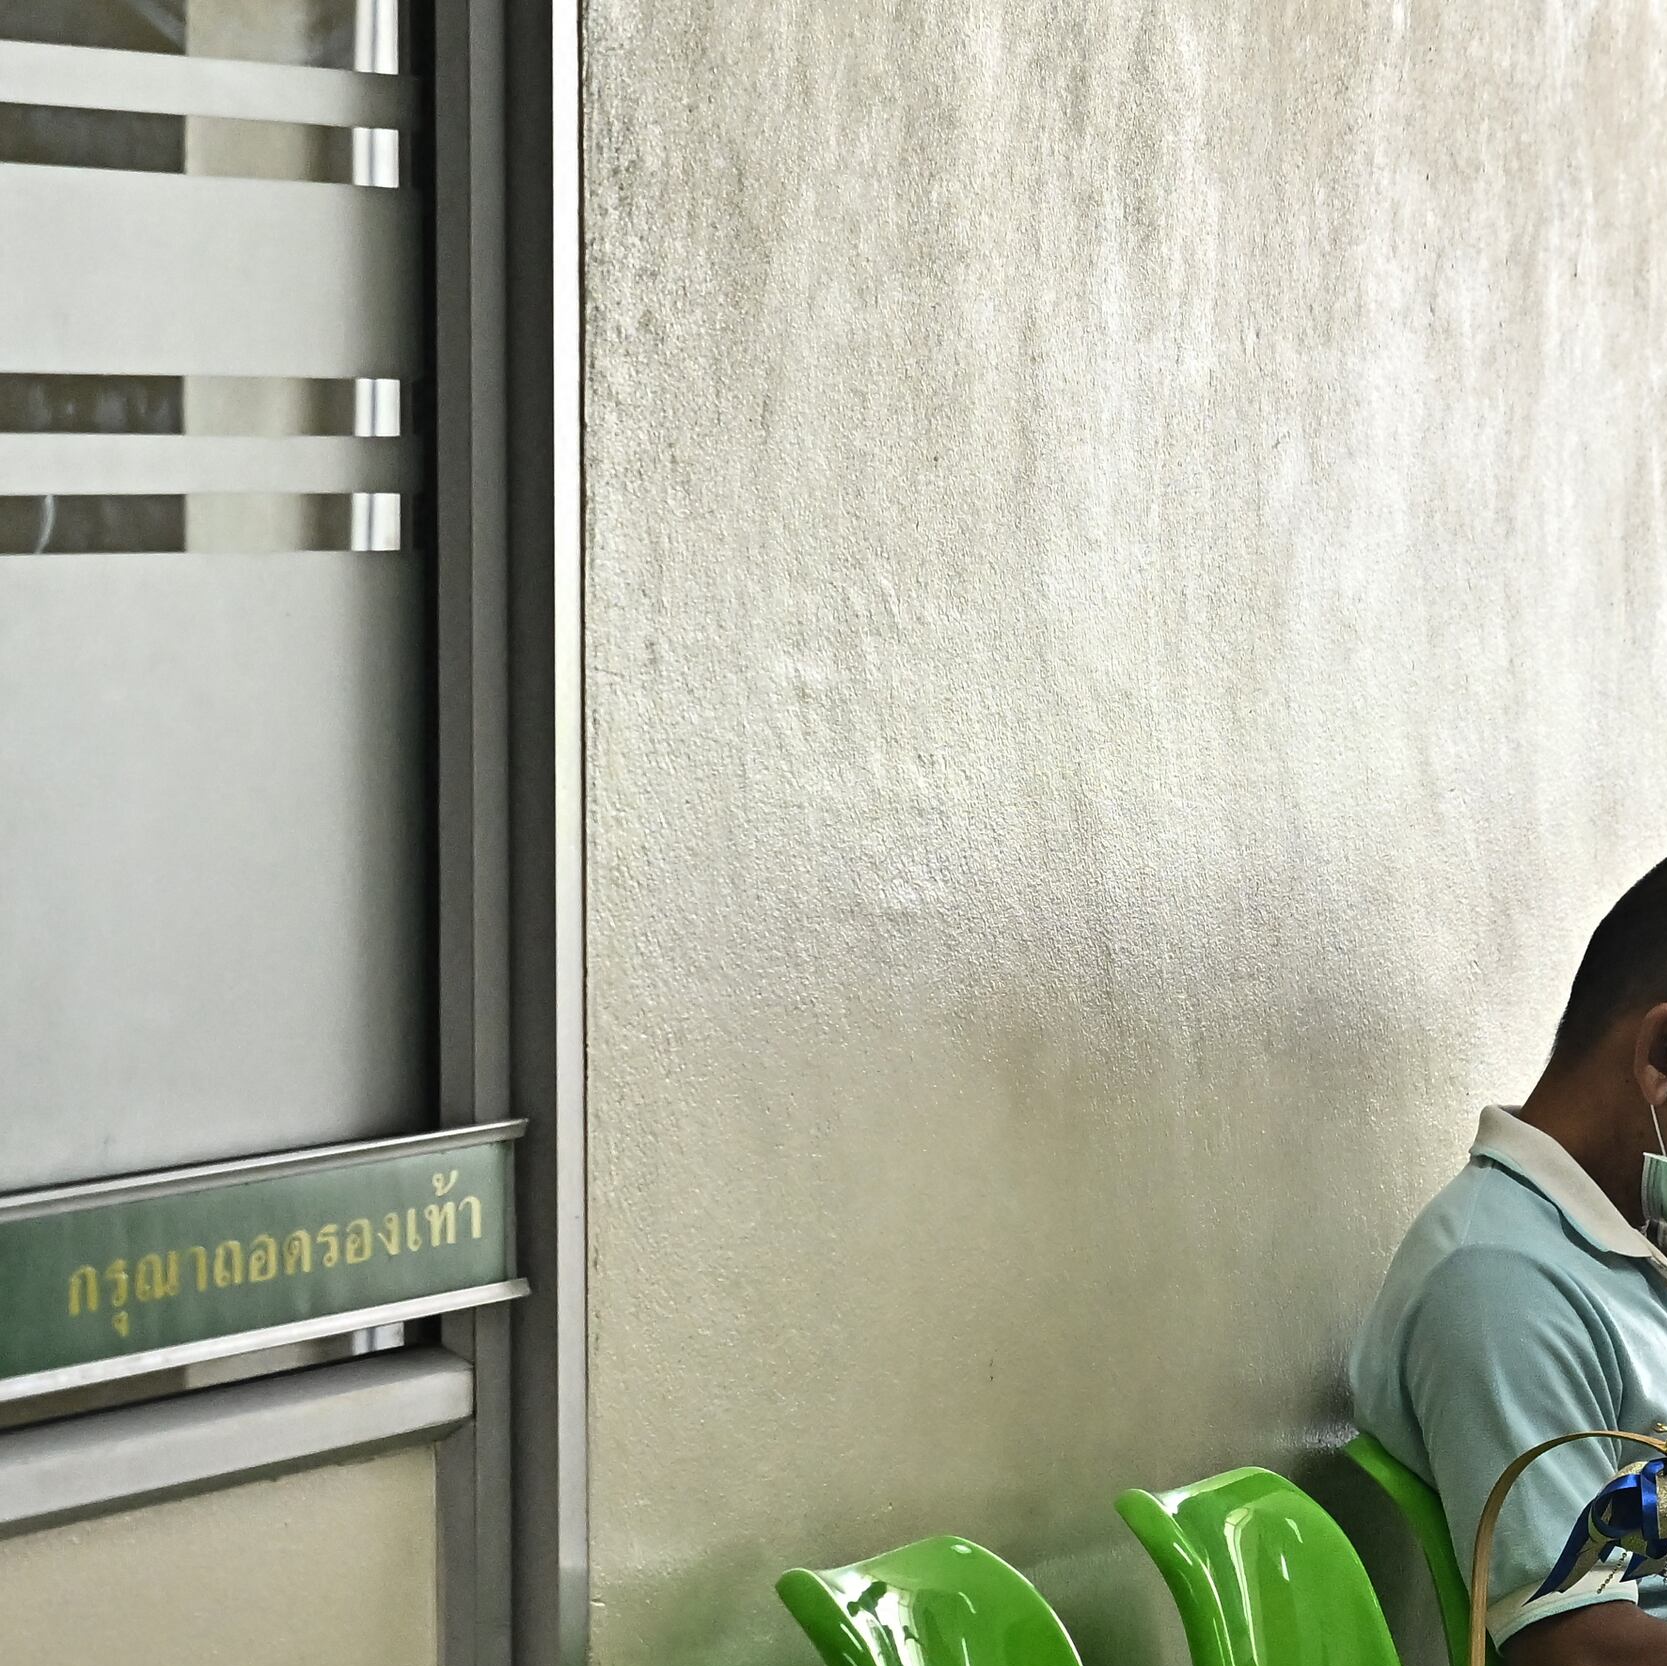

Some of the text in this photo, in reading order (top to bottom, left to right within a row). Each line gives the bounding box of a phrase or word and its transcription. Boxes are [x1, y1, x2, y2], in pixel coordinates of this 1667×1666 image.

[67, 1169, 483, 1338] กรุณาถอดรองเท้า
